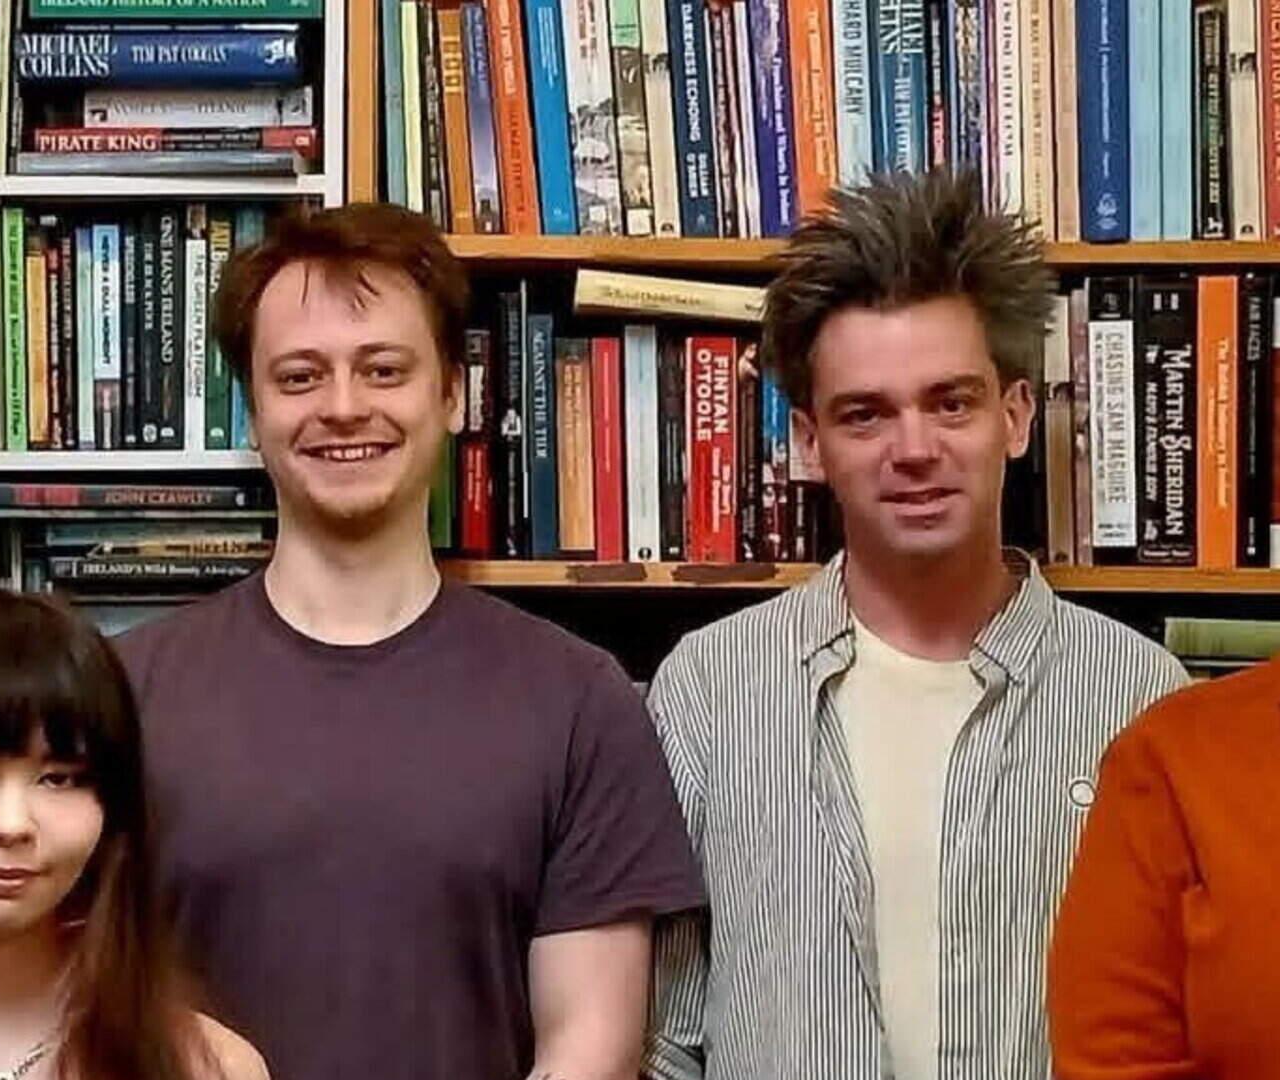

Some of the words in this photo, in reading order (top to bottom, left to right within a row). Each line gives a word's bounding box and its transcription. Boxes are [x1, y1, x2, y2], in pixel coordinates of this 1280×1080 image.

[20, 34, 117, 55] MICHAEL
[20, 54, 110, 78] COLLINS
[843, 45, 865, 116] MULCAHY
[38, 134, 102, 151] PIRATE
[107, 134, 157, 151] KING
[532, 327, 547, 392] AGAINST
[1105, 332, 1125, 396] CHASING
[1161, 344, 1193, 430] MARTIN
[533, 393, 548, 423] THE
[696, 348, 712, 442] O'TOOLE
[713, 356, 729, 434] FINTAN
[1106, 401, 1125, 433] SAM
[1106, 439, 1126, 504] MAGUIRE
[1158, 434, 1193, 536] SHERIDAN
